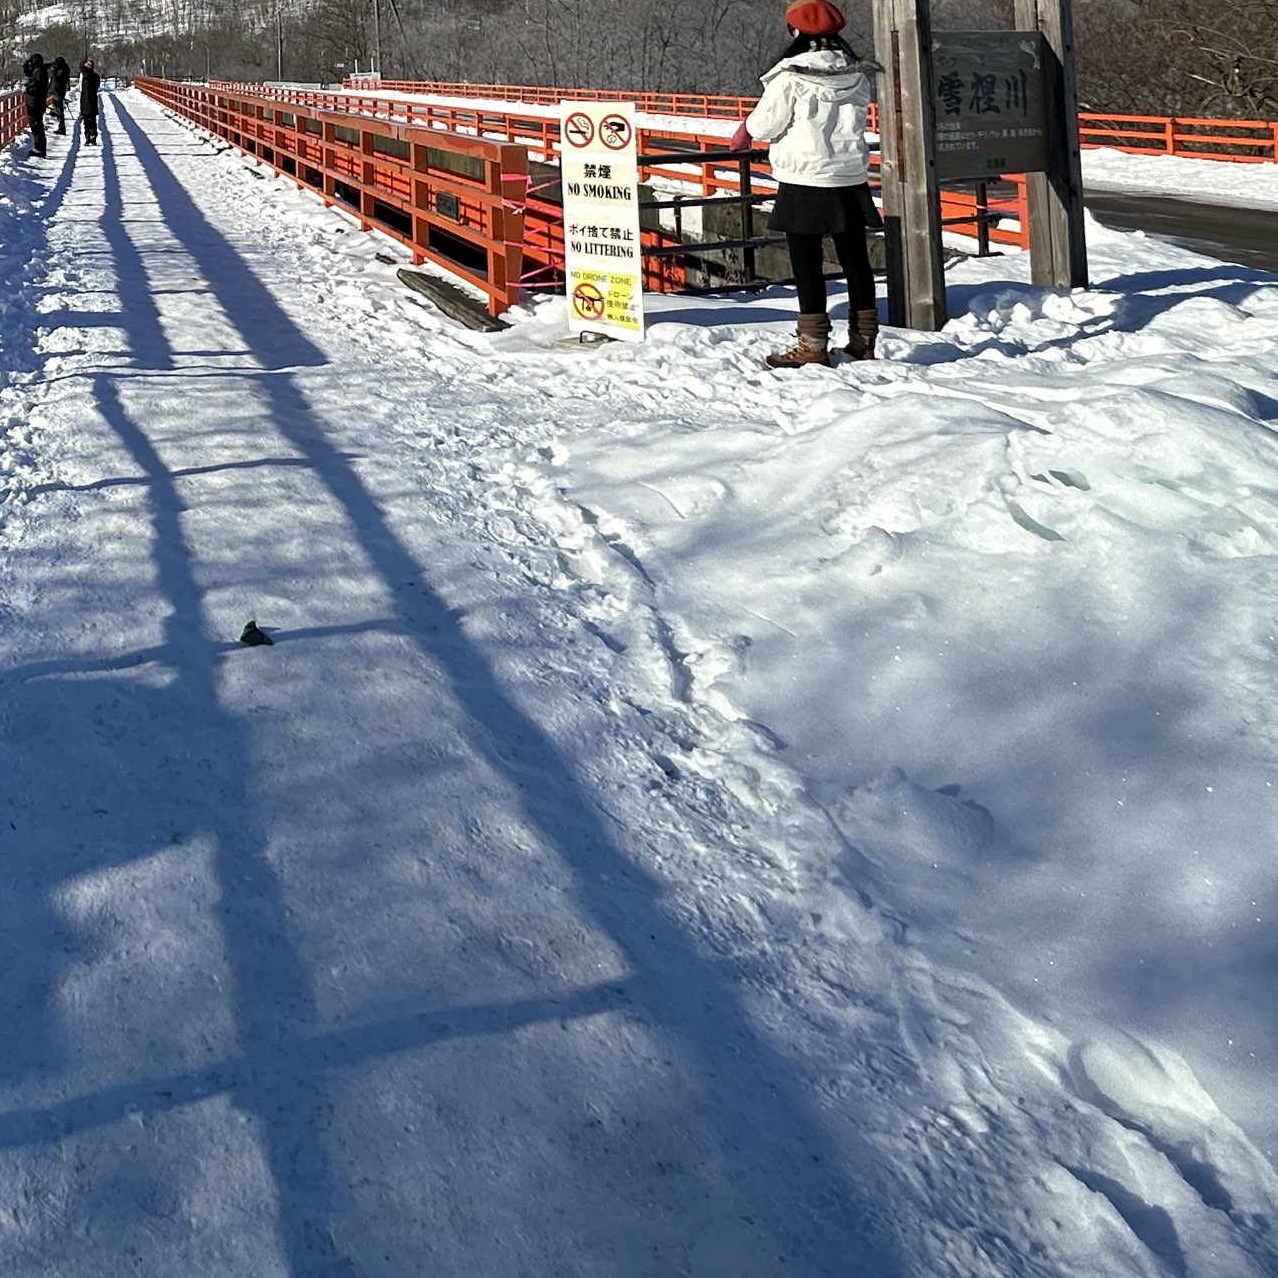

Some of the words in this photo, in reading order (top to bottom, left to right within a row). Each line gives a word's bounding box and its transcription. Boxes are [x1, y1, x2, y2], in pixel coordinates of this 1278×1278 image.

[937, 68, 1027, 117] 雪裡川
[583, 163, 612, 179] 禁煙
[567, 182, 580, 196] NO
[583, 183, 631, 200] SMOKING
[569, 223, 634, 241] ポイ捨て禁止
[570, 240, 582, 253] NO
[584, 242, 633, 258] LITTERING
[570, 271, 581, 279] NO
[583, 272, 608, 282] DRONE
[610, 276, 632, 286] ZONE
[608, 290, 634, 300] ドローン
